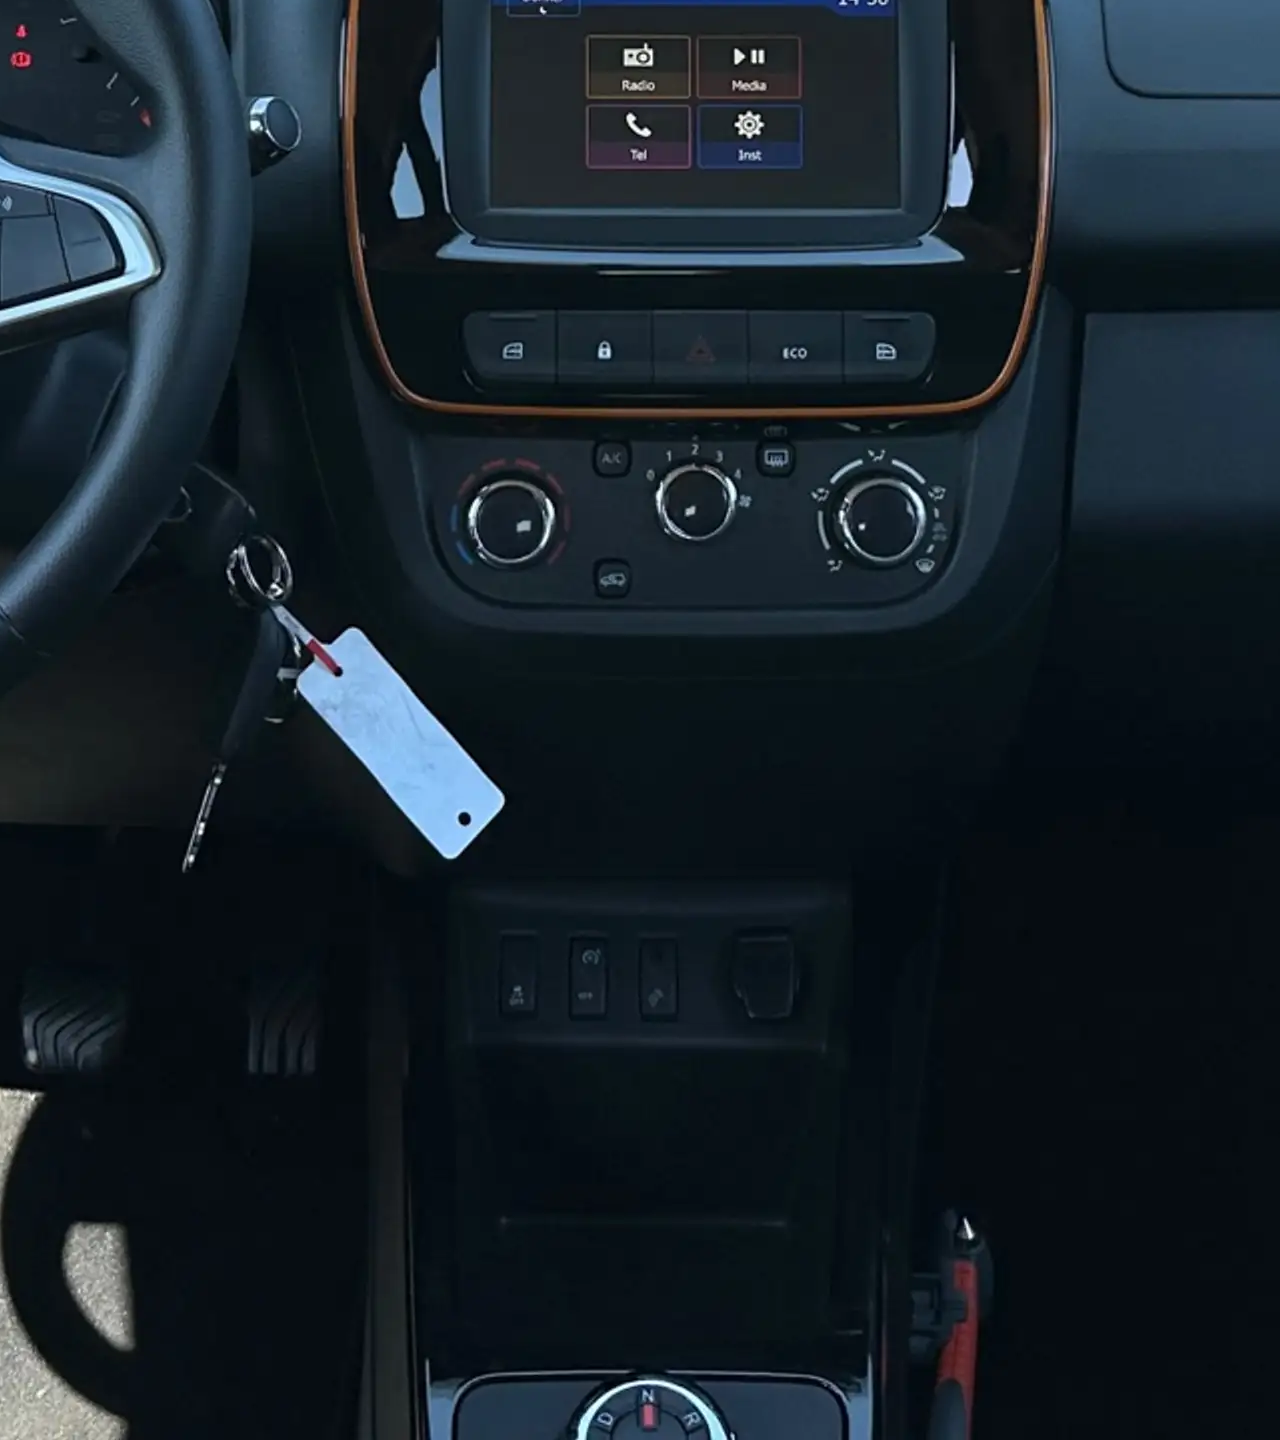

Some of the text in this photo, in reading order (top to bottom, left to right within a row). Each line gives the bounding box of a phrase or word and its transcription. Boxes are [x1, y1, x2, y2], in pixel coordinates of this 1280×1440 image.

[621, 79, 656, 92] Radio
[732, 79, 768, 92] Media
[630, 148, 648, 161] Tel
[737, 148, 763, 161] Inst
[783, 347, 808, 360] ECO
[601, 452, 622, 464] A/C
[666, 451, 673, 462] 1
[691, 445, 700, 456] 2
[715, 451, 724, 462] 3
[641, 1388, 654, 1402] N
[596, 1412, 614, 1427] D
[683, 1411, 702, 1427] R
